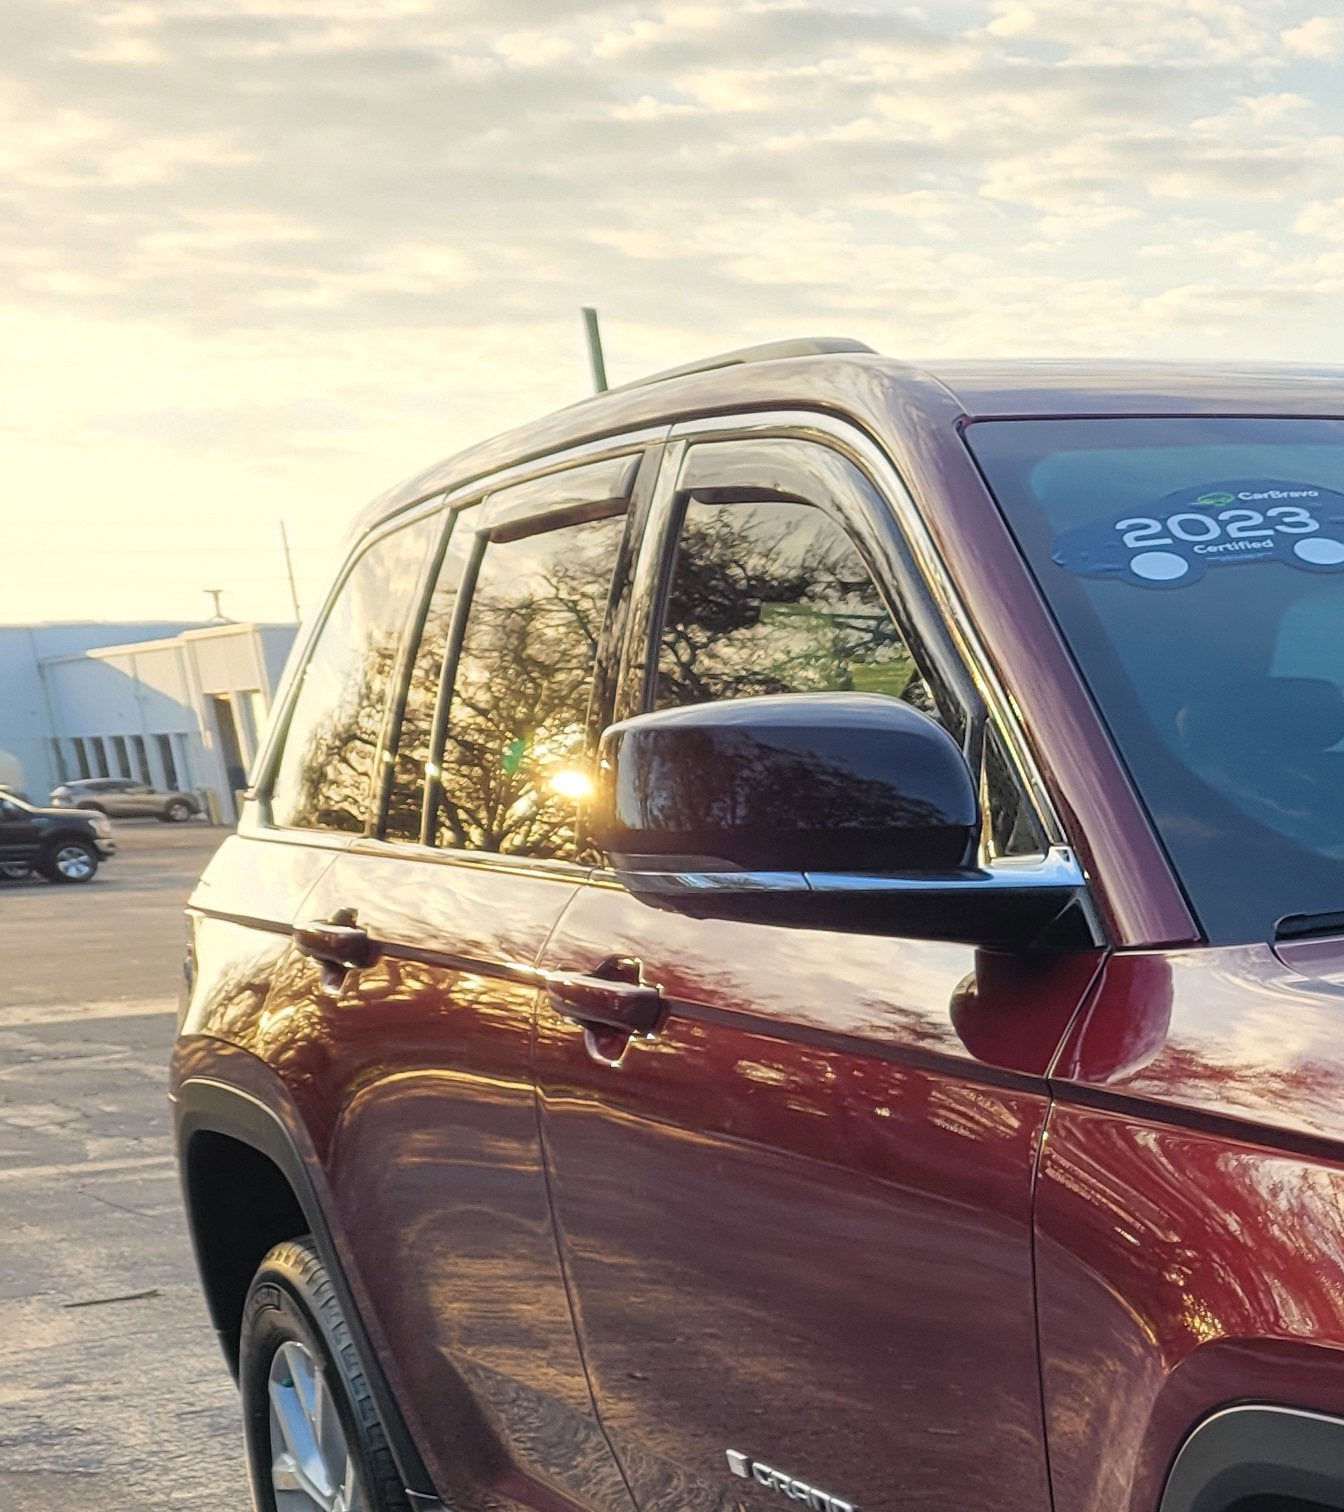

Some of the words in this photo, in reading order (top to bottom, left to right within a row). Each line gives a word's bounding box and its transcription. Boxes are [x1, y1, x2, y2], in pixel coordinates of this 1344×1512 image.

[1237, 488, 1319, 500] CarBravo
[1115, 506, 1320, 548] 2023
[1193, 539, 1274, 553] Certified
